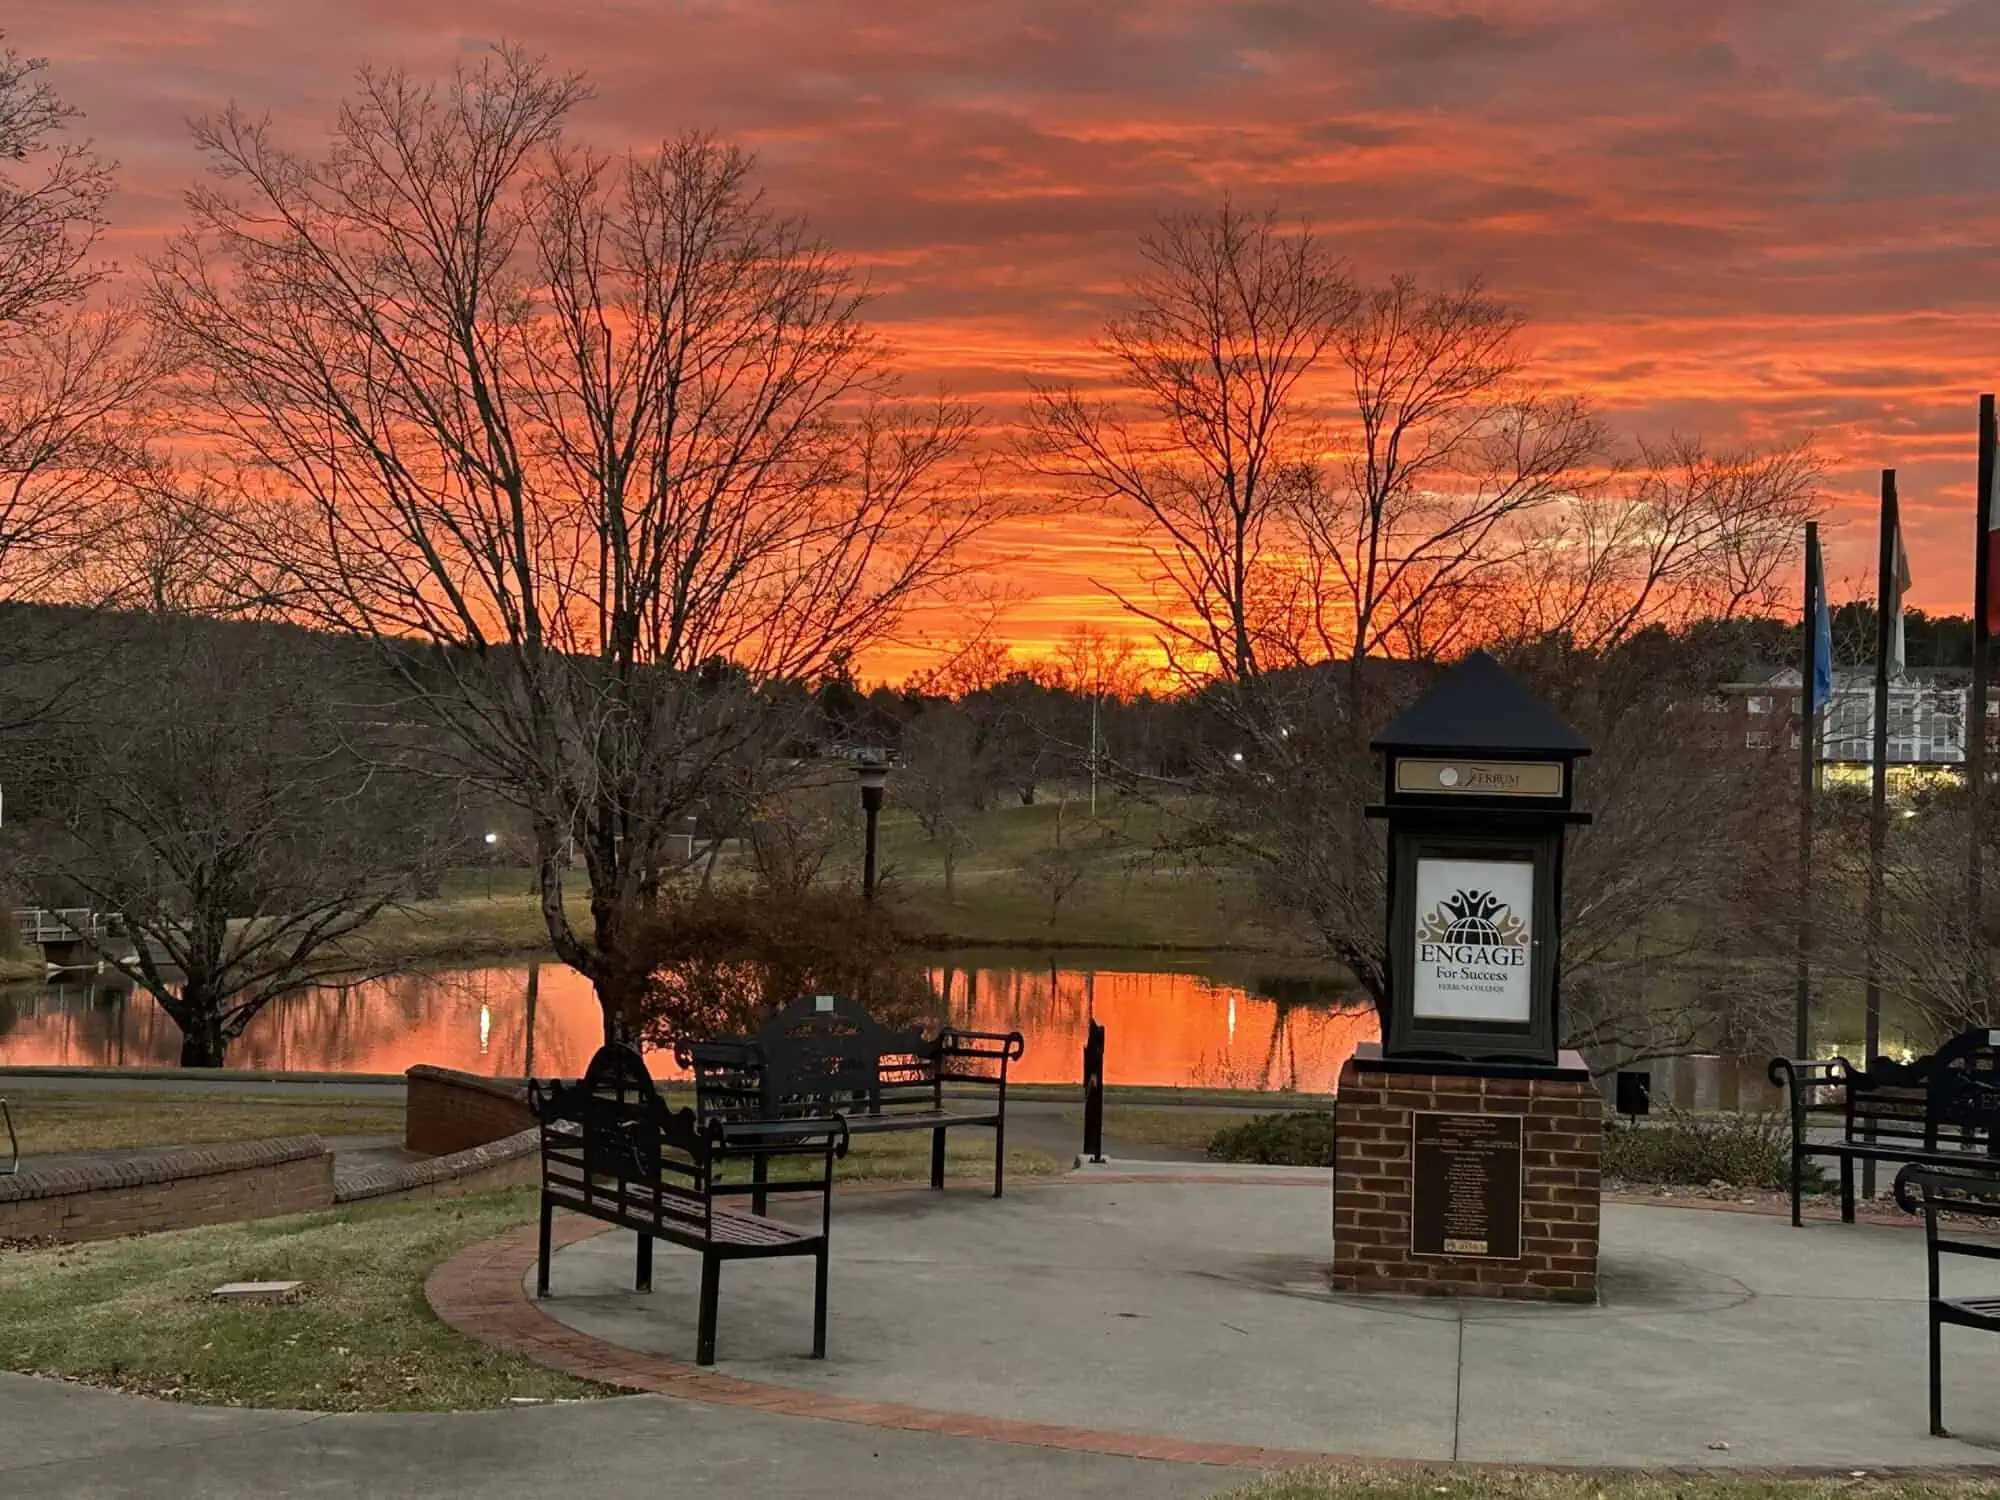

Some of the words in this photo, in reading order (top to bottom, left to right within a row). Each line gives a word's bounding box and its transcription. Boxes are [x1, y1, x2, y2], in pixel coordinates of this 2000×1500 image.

[1420, 944, 1525, 966] ENGAGE
[1436, 966, 1458, 979] For
[1460, 967, 1508, 981] Success
